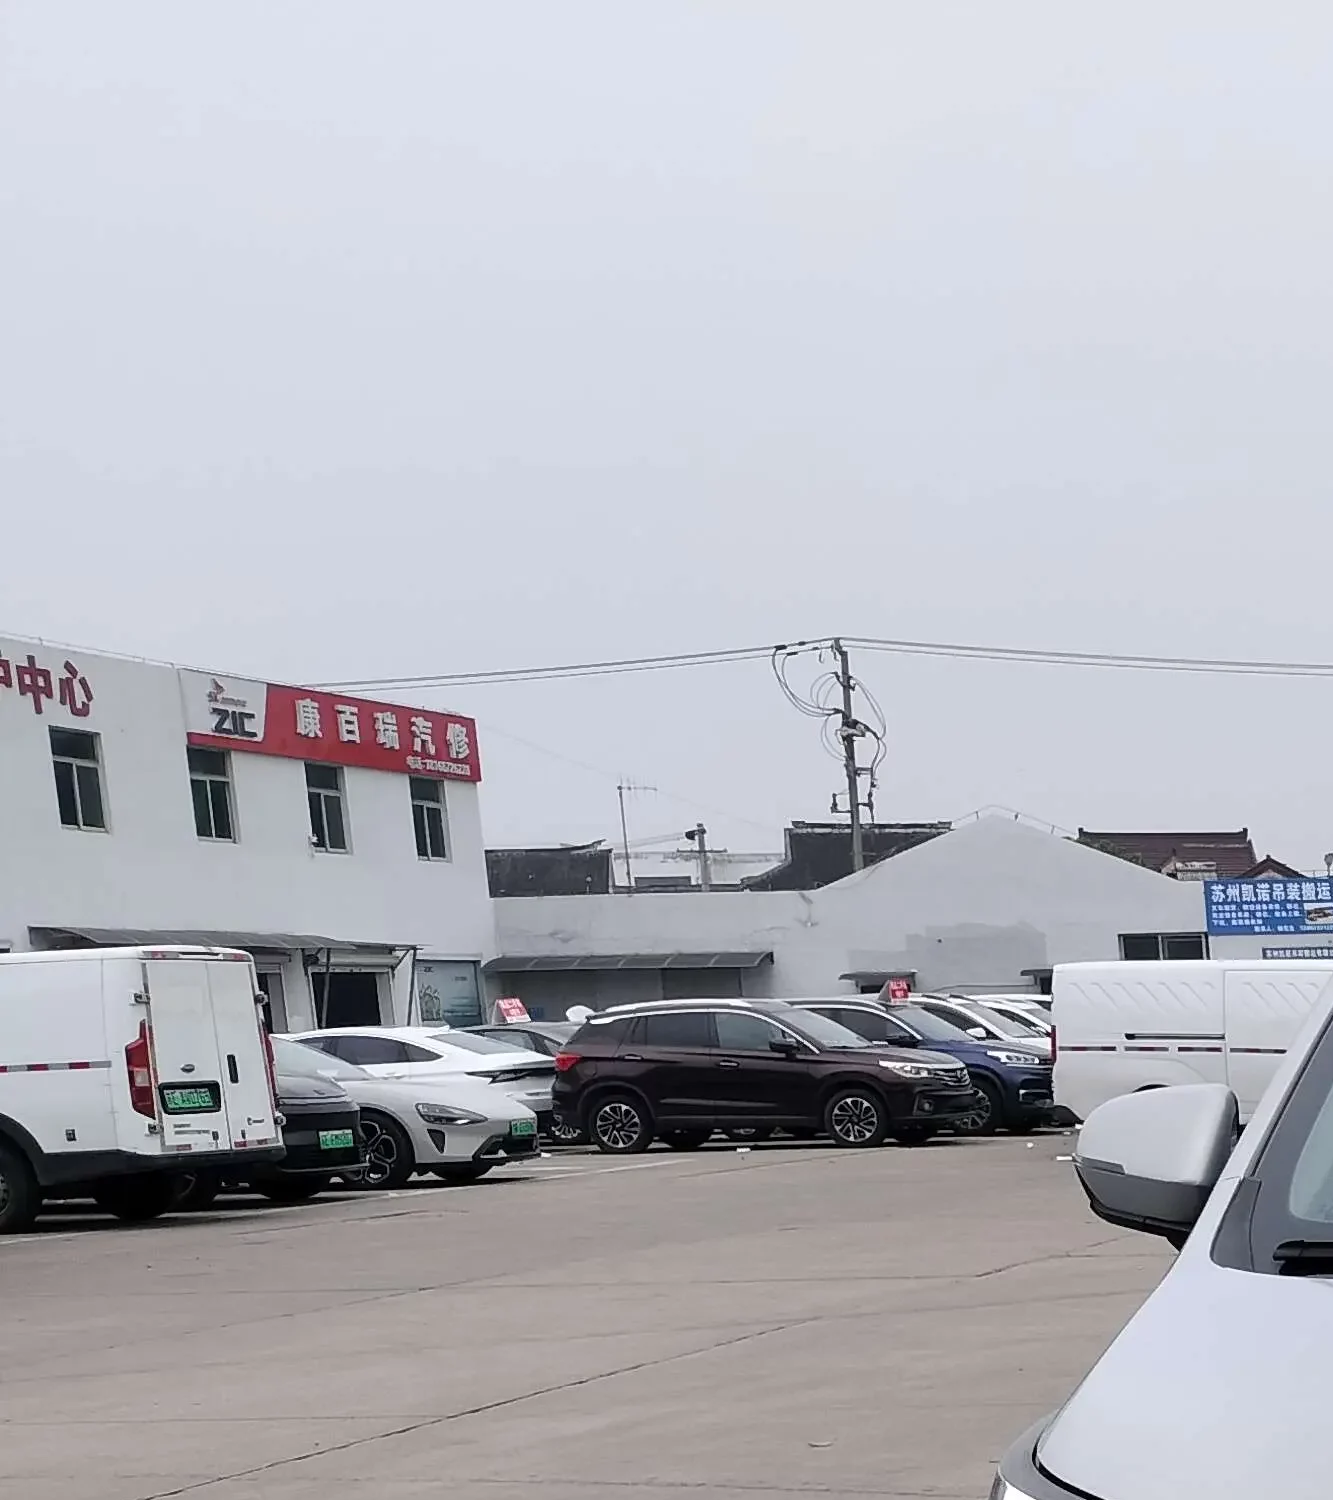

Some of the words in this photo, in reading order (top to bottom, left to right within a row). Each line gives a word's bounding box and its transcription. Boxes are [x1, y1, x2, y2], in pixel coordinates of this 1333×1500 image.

[211, 707, 258, 738] ZIC
[295, 698, 470, 759] 康百瑞汽修
